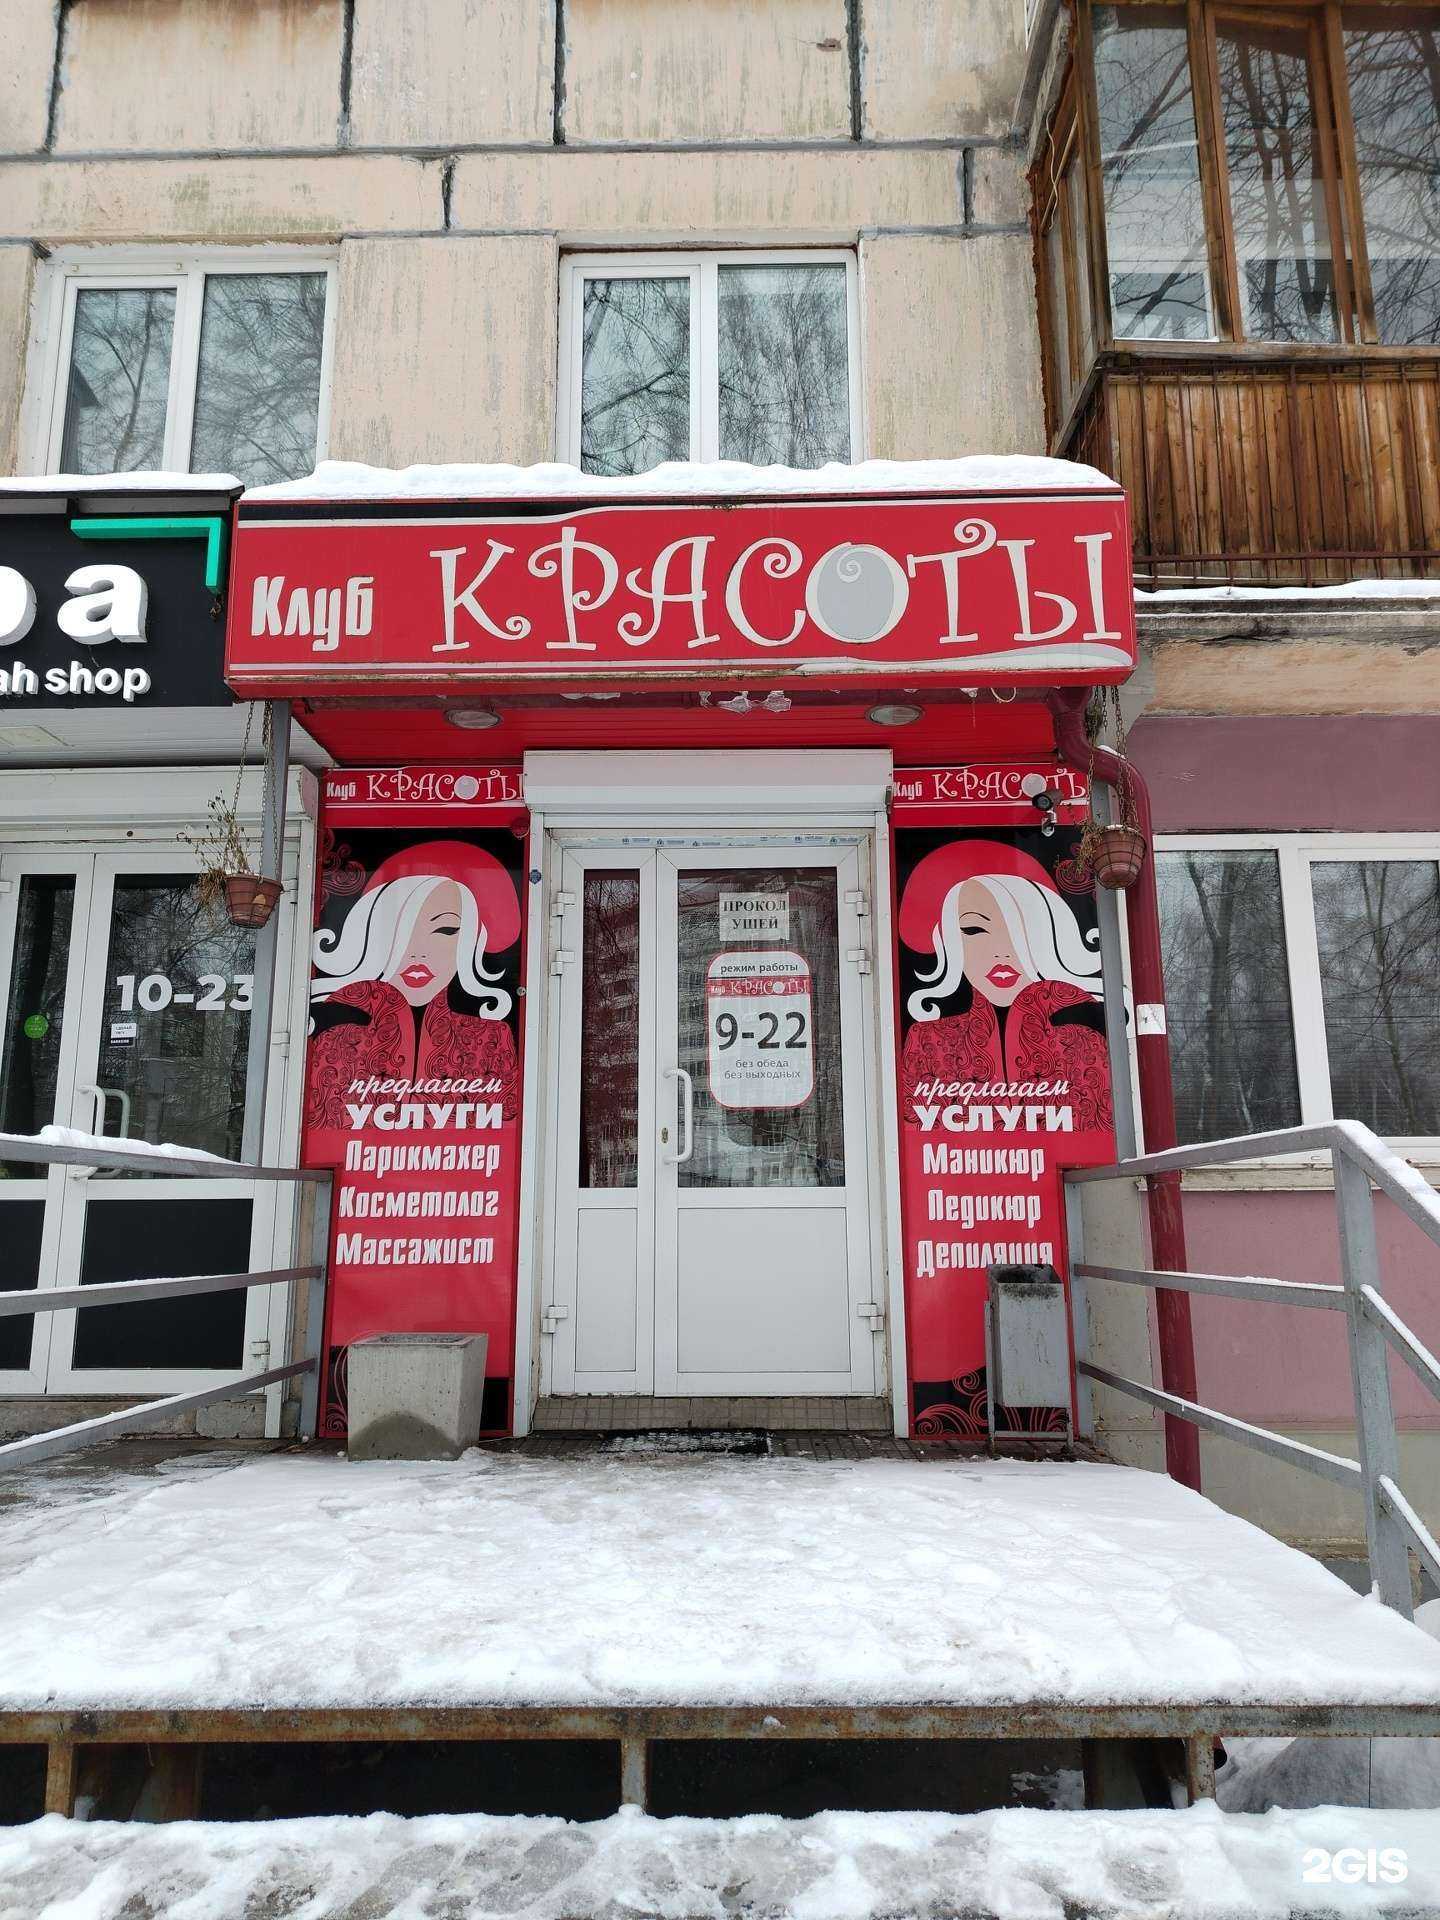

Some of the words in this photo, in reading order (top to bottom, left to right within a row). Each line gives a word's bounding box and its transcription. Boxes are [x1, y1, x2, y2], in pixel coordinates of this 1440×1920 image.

[251, 576, 374, 652] Клуб
[428, 517, 1123, 653] КРАСОТЫ
[44, 660, 151, 702] shop
[326, 781, 356, 801] Клуб
[893, 781, 923, 800] Клуб
[723, 901, 786, 913] ПРОКОЛ
[732, 916, 779, 931] УШЕЙ
[720, 964, 756, 975] режим
[759, 962, 798, 974] работы
[116, 974, 255, 1012] 10-23
[730, 977, 808, 995] КРАСОТЫ
[715, 1011, 808, 1050] 9-22
[724, 1070, 743, 1079] без
[745, 1070, 801, 1080] выходных
[735, 1059, 754, 1069] без
[756, 1059, 790, 1069] обеда
[347, 1075, 503, 1101] предлагаем
[913, 1078, 1071, 1105] предлагаем
[345, 1103, 504, 1131] УСЛУГИ
[912, 1105, 1074, 1133] УСЛУГИ
[345, 1140, 501, 1179] Парикмахер
[922, 1143, 1046, 1182] Маникюр
[338, 1186, 500, 1218] Косметолог
[928, 1189, 1042, 1230] Педикюр
[335, 1233, 495, 1265] Массажист
